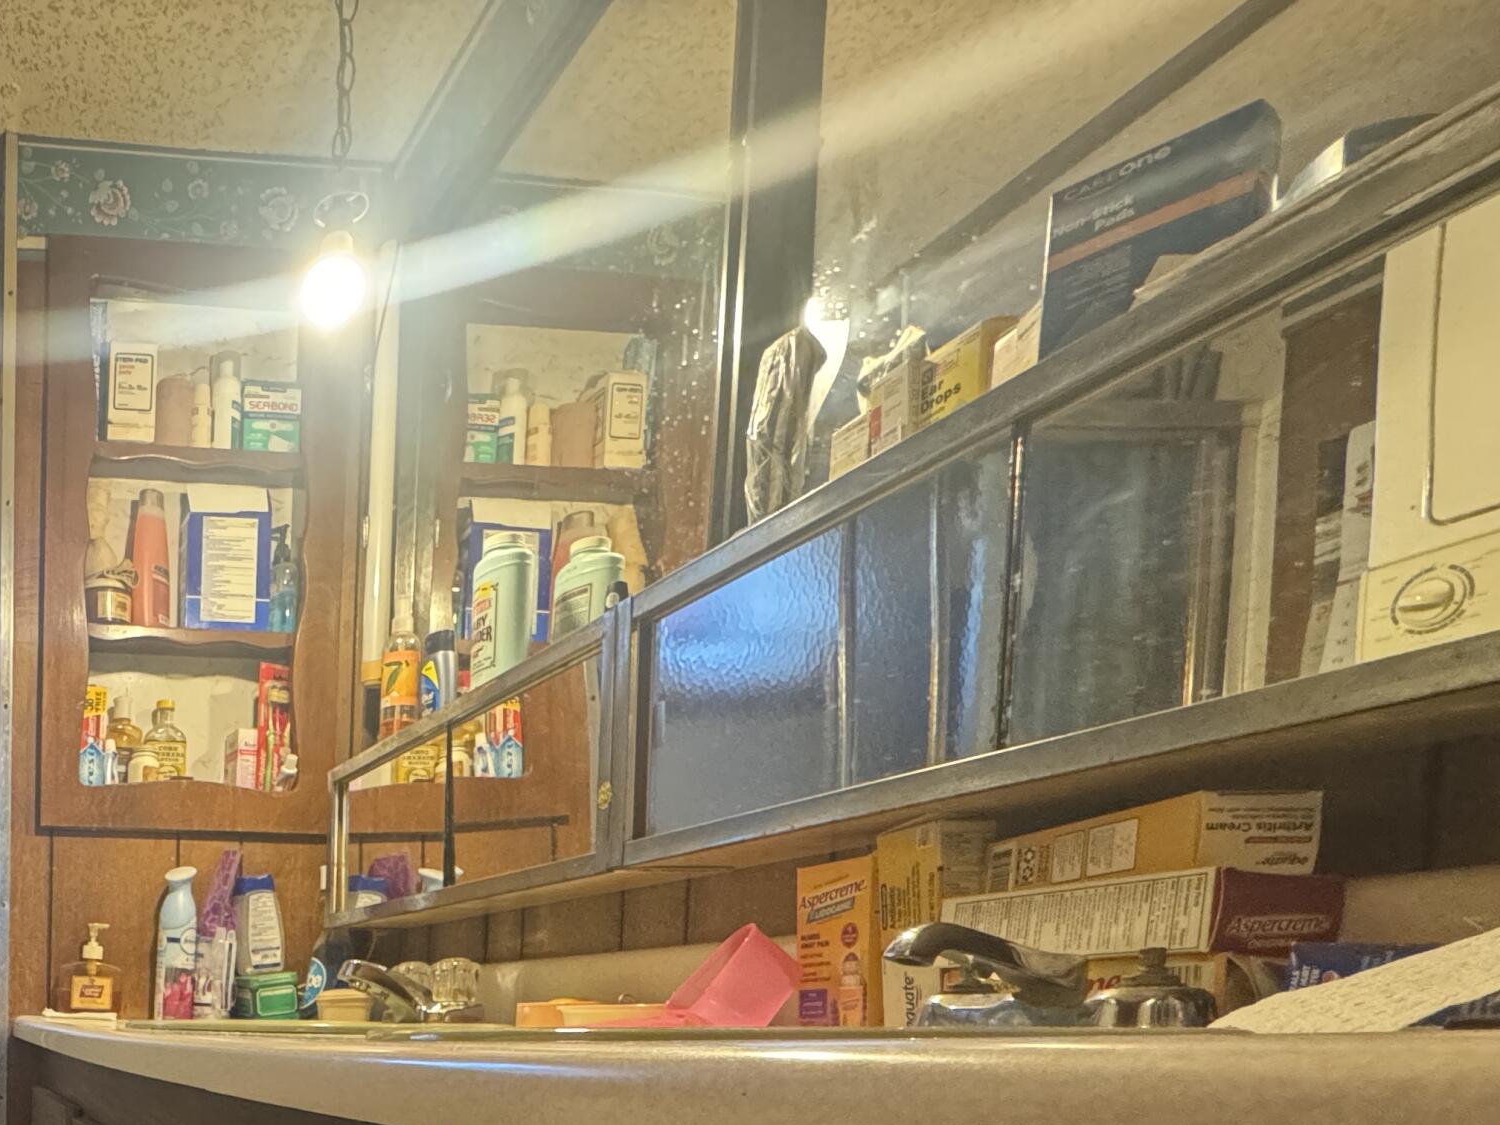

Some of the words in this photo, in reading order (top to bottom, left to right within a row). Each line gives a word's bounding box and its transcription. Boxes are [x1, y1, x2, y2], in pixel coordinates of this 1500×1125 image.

[920, 382, 961, 415] Drops
[921, 379, 944, 400] Ear
[1205, 822, 1252, 832] Cream
[1255, 822, 1314, 831] Arthritis
[798, 879, 868, 911] Aspercreme
